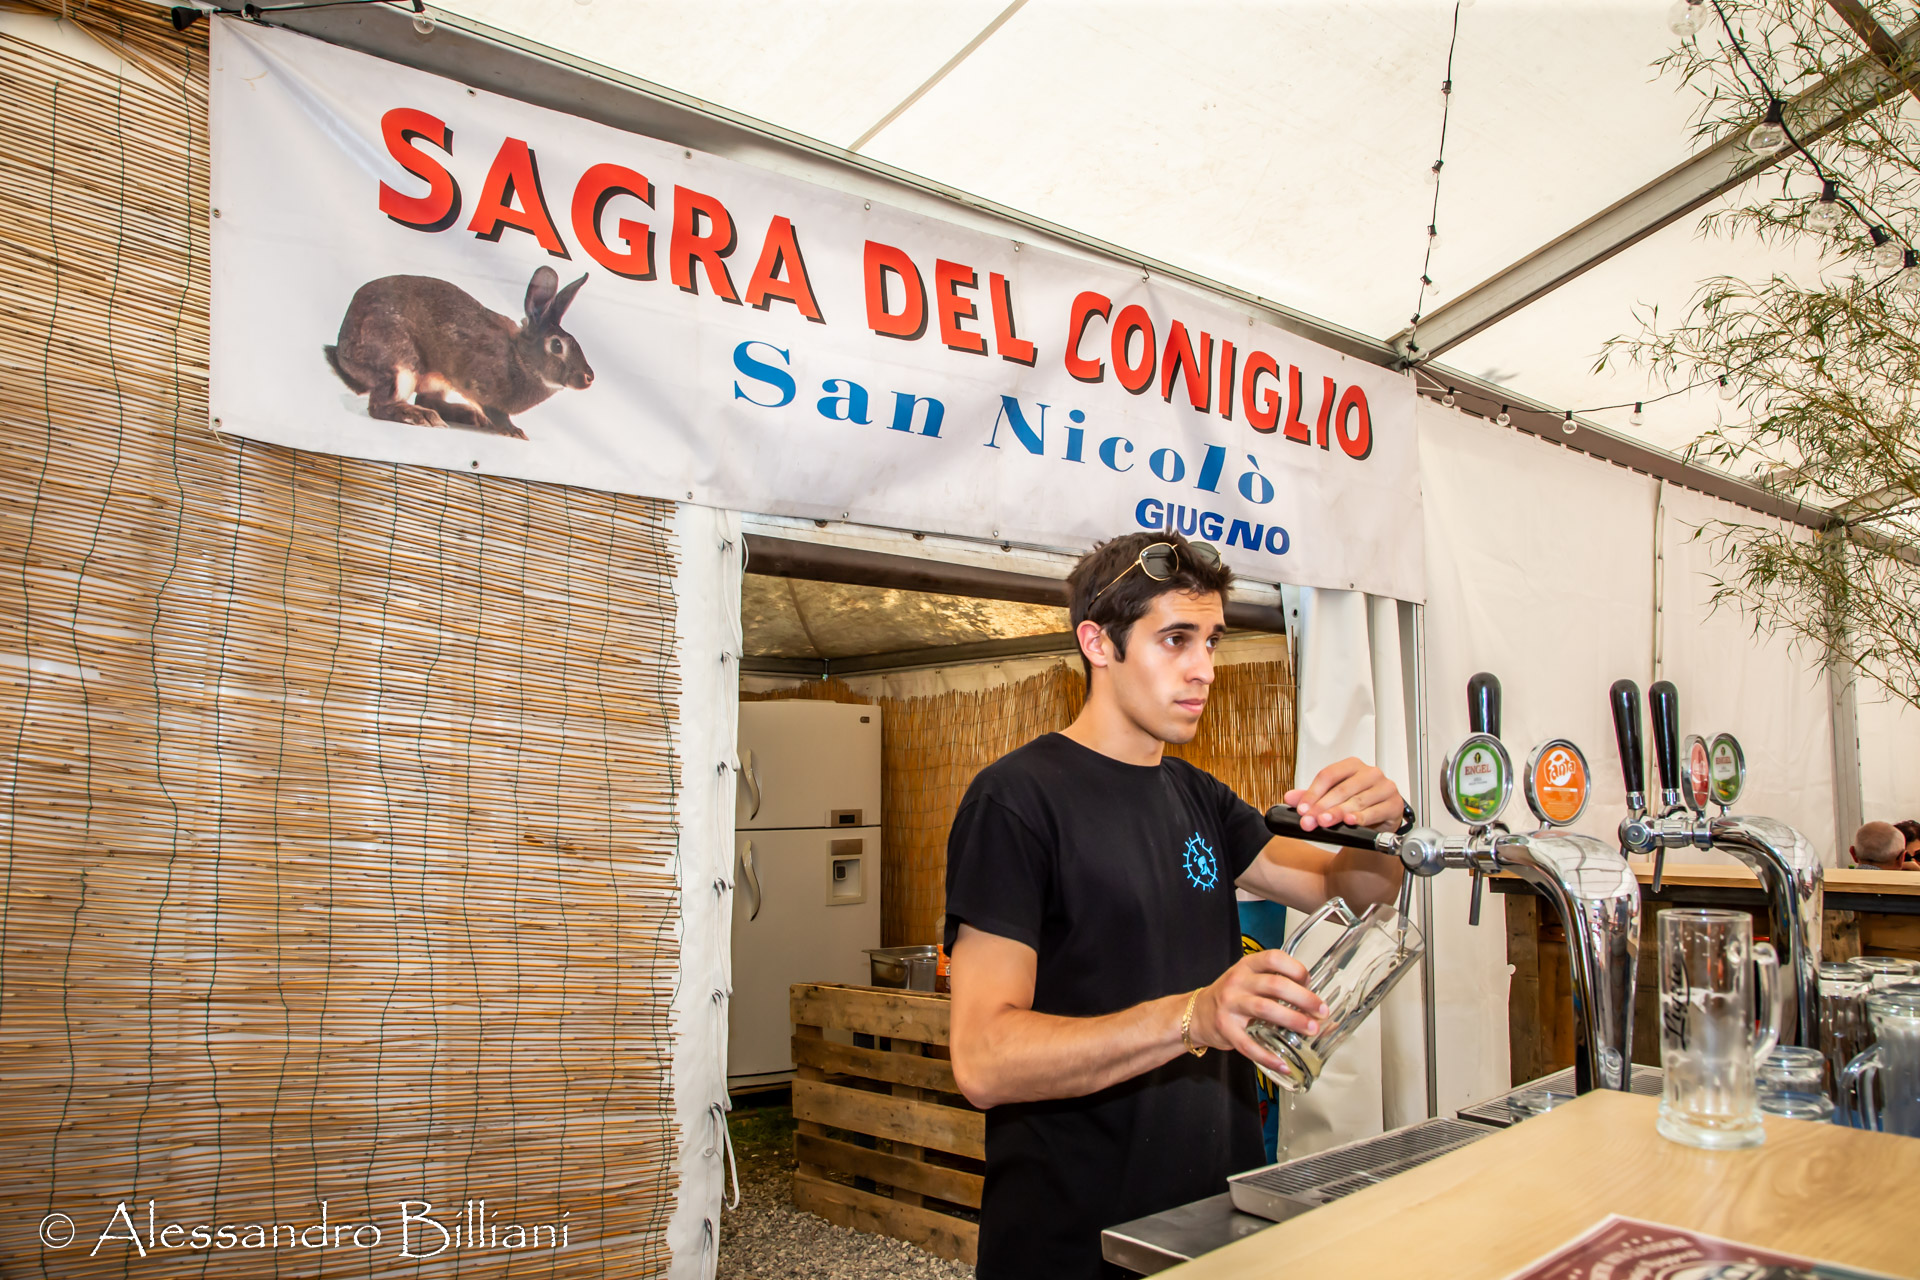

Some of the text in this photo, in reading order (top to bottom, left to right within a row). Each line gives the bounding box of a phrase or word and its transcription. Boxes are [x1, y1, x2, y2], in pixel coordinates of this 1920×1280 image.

[379, 107, 1373, 460] SAGRA DEL CONIGLIO
[733, 340, 1275, 504] San Nicolò
[1135, 498, 1290, 556] GIUGNO
[1464, 764, 1492, 776] ENGEL
